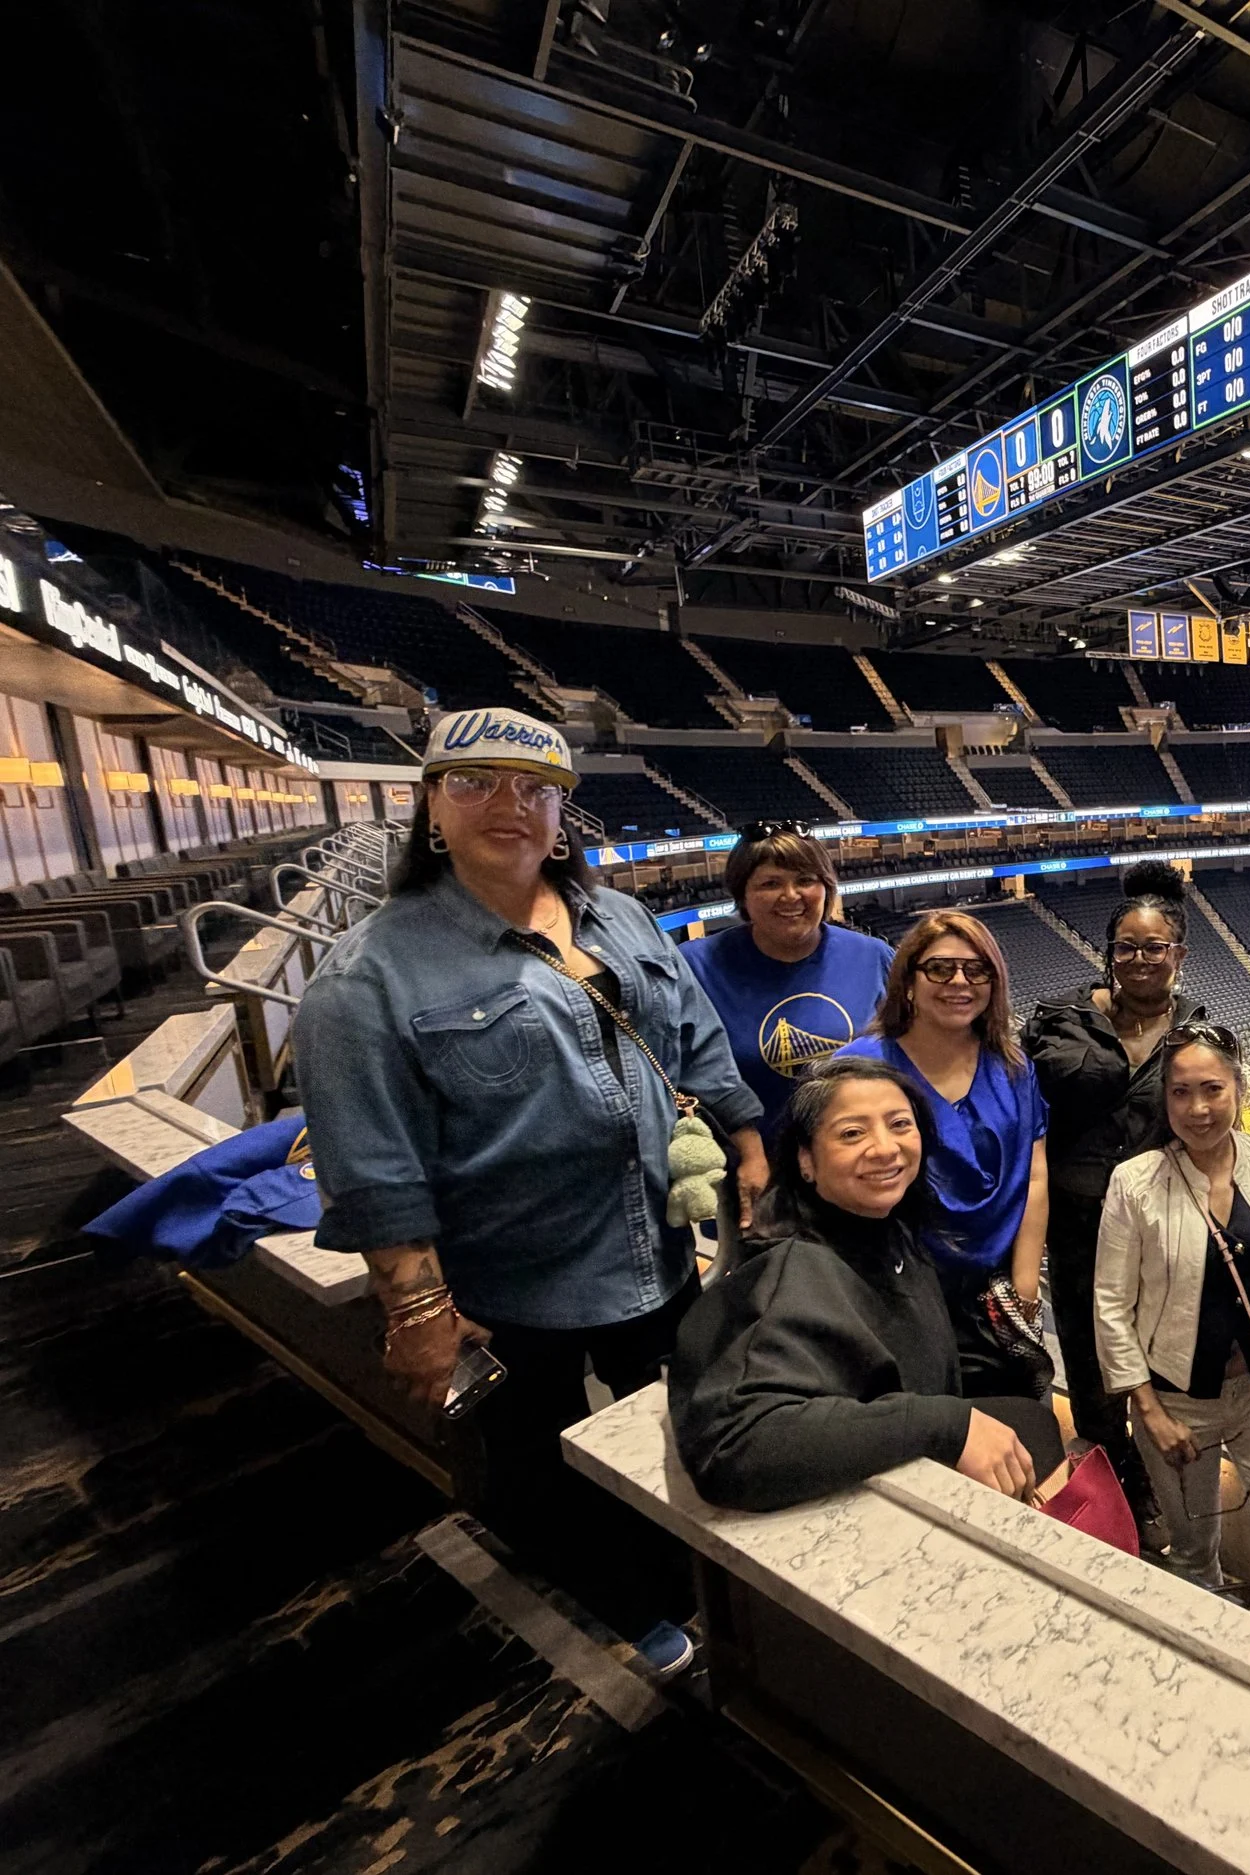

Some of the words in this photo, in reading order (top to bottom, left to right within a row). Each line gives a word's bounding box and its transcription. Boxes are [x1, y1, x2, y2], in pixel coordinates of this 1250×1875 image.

[1211, 288, 1235, 316] SHOT
[1137, 338, 1152, 360] FOUR
[1152, 325, 1179, 351] FACTORS
[1195, 341, 1207, 357] FG
[1223, 315, 1243, 343] 0/0
[1171, 346, 1185, 366] 0.0
[1196, 368, 1212, 386] 3PT
[1224, 346, 1243, 373] 0/0
[1172, 368, 1186, 388] 0.0
[1172, 389, 1187, 409] 0.0
[1197, 400, 1208, 415] FT
[1225, 377, 1244, 403] 0/0
[1051, 408, 1064, 448] 0
[1143, 426, 1160, 442] RATE
[1173, 410, 1187, 430] 0.0
[1015, 431, 1026, 468] 0
[1057, 455, 1069, 468] TOL
[1027, 460, 1055, 492] 99:00
